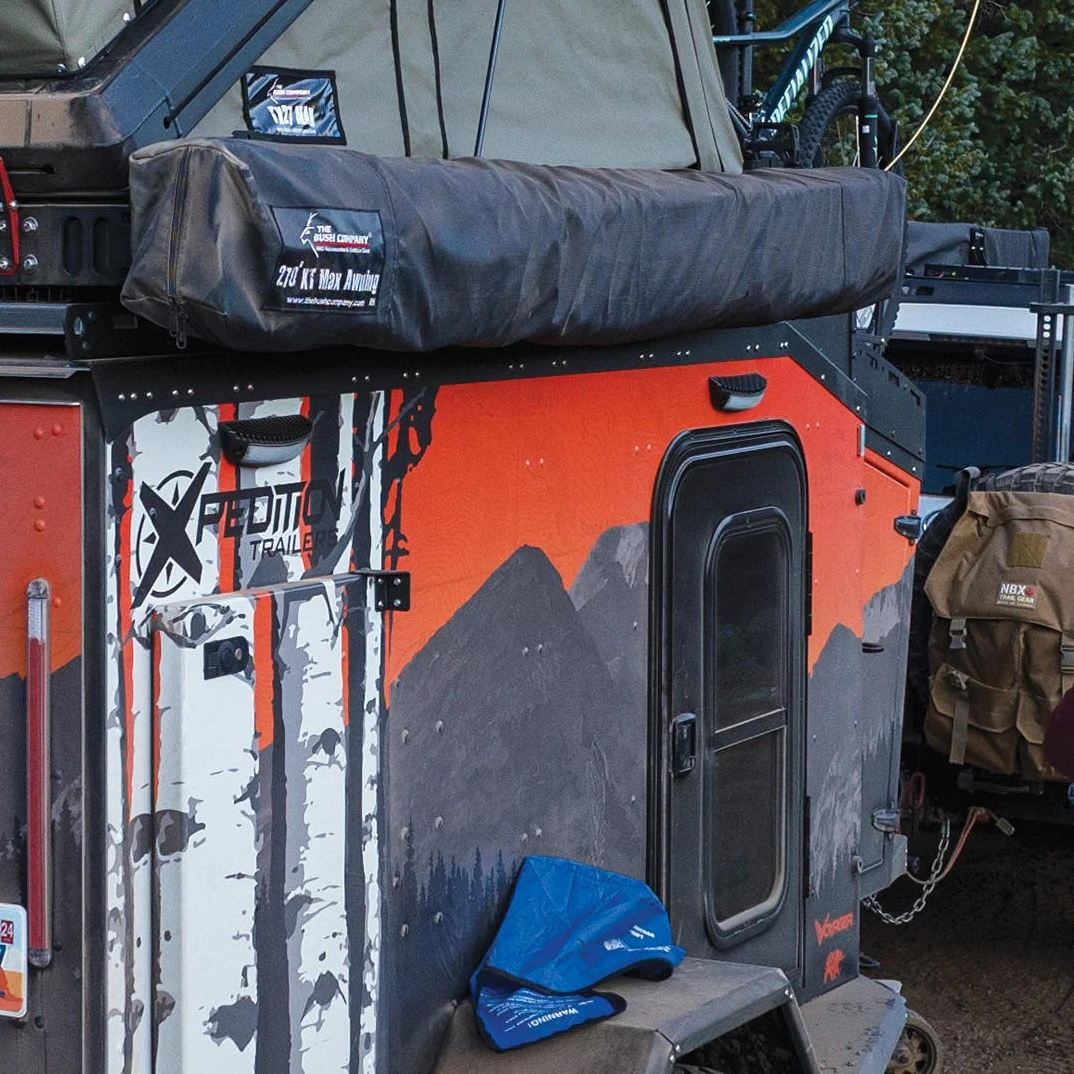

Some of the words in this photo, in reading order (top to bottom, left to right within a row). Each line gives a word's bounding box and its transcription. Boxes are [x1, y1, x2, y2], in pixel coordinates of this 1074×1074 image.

[767, 14, 834, 123] PECIALIZED
[316, 225, 332, 233] THE
[313, 233, 336, 243] BUSH
[318, 268, 343, 291] Max
[343, 269, 381, 295] Awning
[249, 528, 340, 561] TRAILERS
[1000, 583, 1027, 596] NBX
[0, 921, 13, 938] 24
